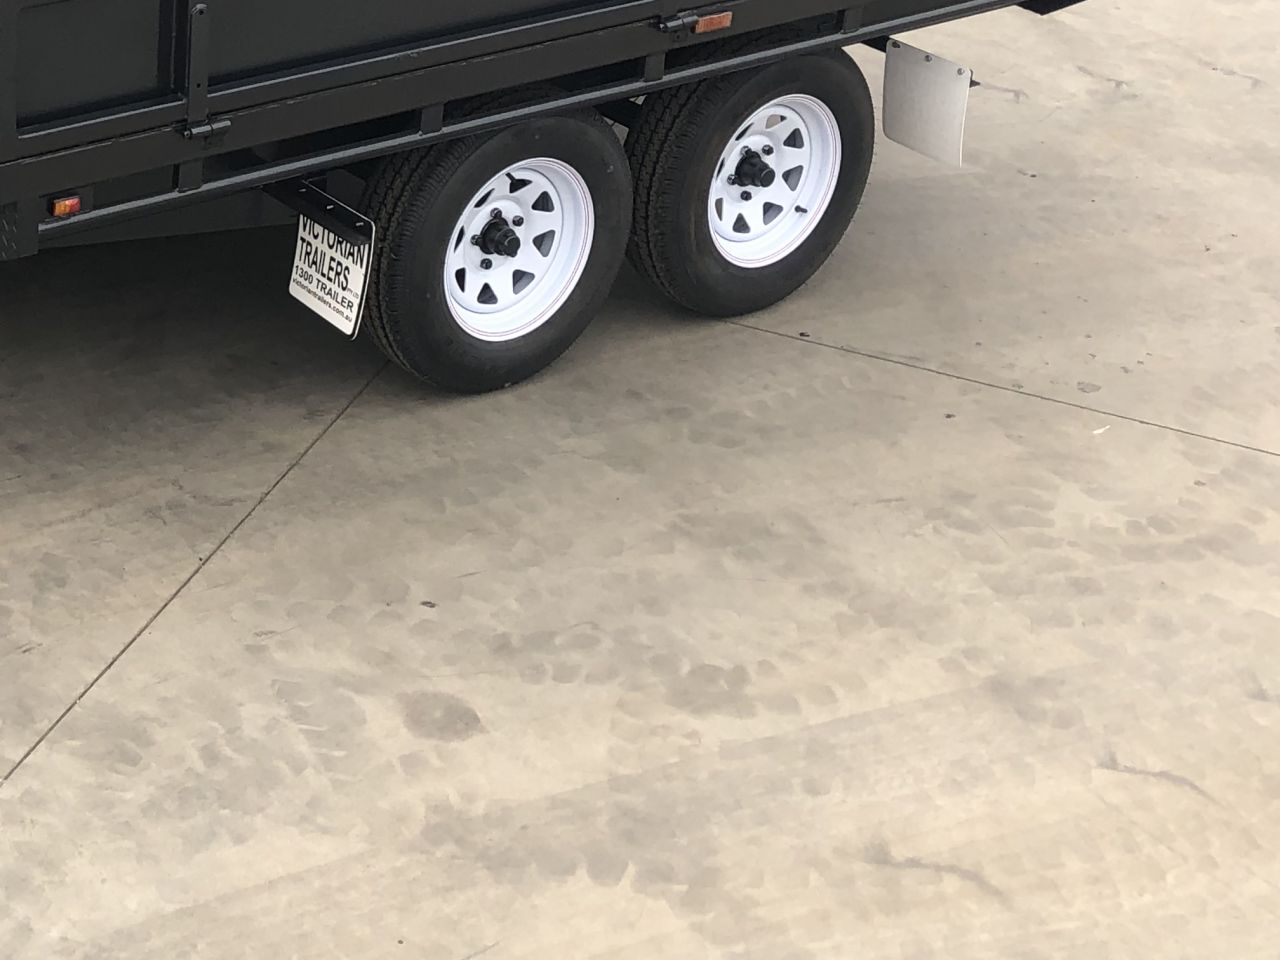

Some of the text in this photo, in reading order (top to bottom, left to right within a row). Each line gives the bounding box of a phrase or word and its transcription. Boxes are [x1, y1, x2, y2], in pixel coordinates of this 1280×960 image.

[298, 236, 350, 291] TRAILERS
[302, 216, 367, 269] VICTORIAN
[295, 265, 354, 313] 1300 TRAILER
